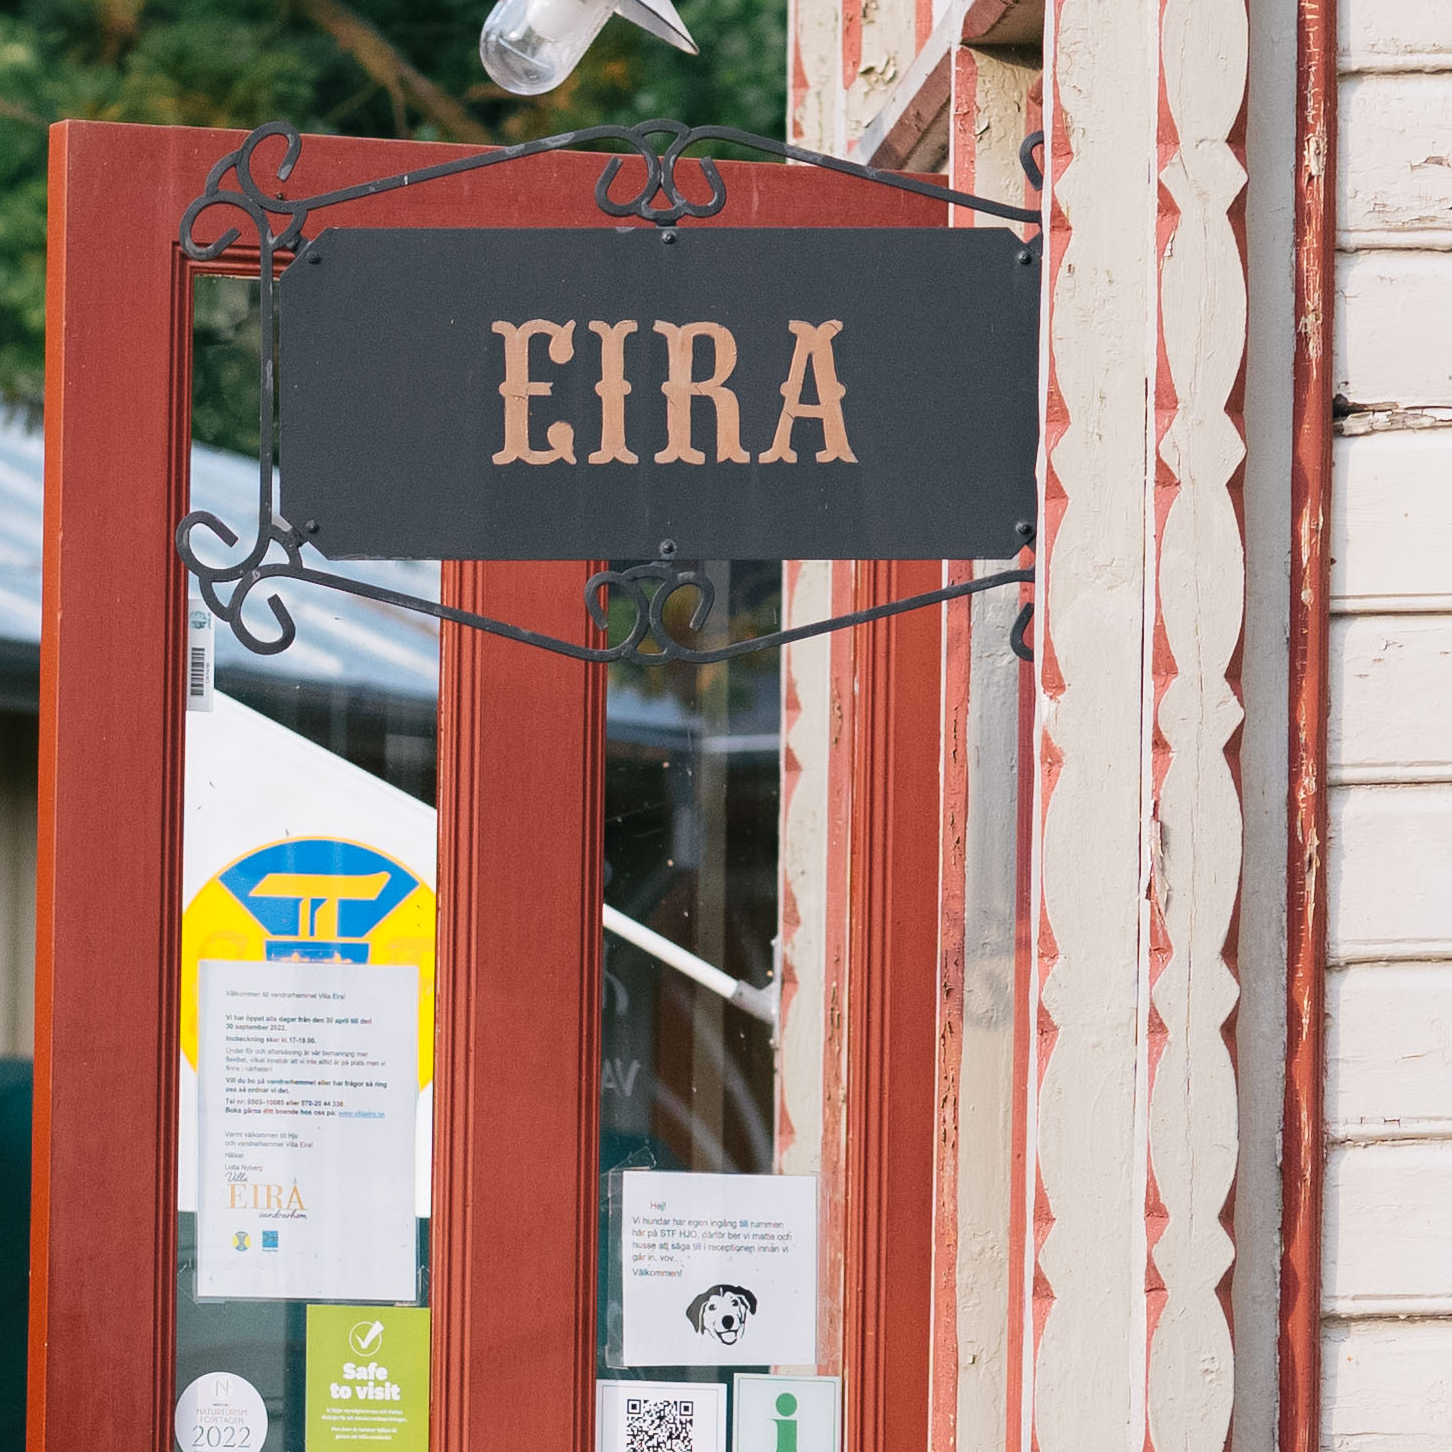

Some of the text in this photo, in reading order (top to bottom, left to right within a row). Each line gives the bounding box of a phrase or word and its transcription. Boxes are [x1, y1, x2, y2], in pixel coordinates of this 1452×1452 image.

[491, 319, 858, 466] EIRA
[227, 1182, 307, 1210] EIRA
[343, 1362, 388, 1380] Safe
[329, 1381, 401, 1401] to visit
[192, 1425, 251, 1448] 2022
